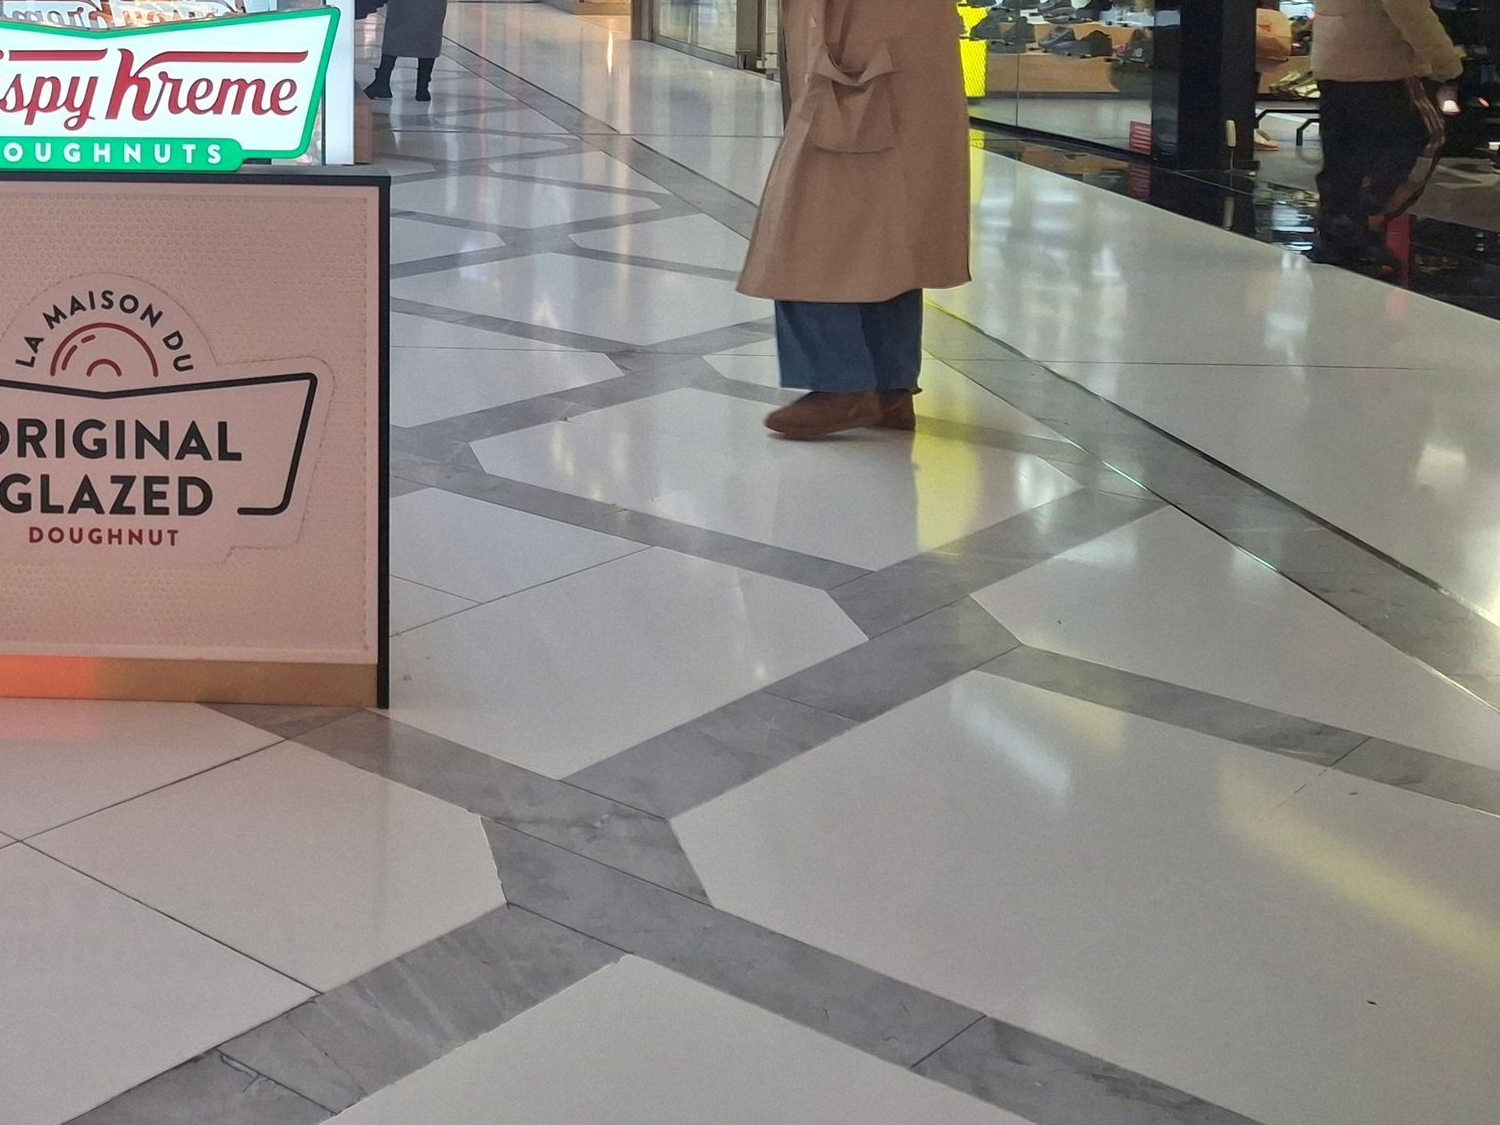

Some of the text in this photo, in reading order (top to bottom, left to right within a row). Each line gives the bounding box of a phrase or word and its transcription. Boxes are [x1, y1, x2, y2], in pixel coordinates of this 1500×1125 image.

[105, 47, 309, 122] Kreme
[14, 290, 195, 373] LA MAISON DU
[28, 526, 180, 547] DOUGHNUT
